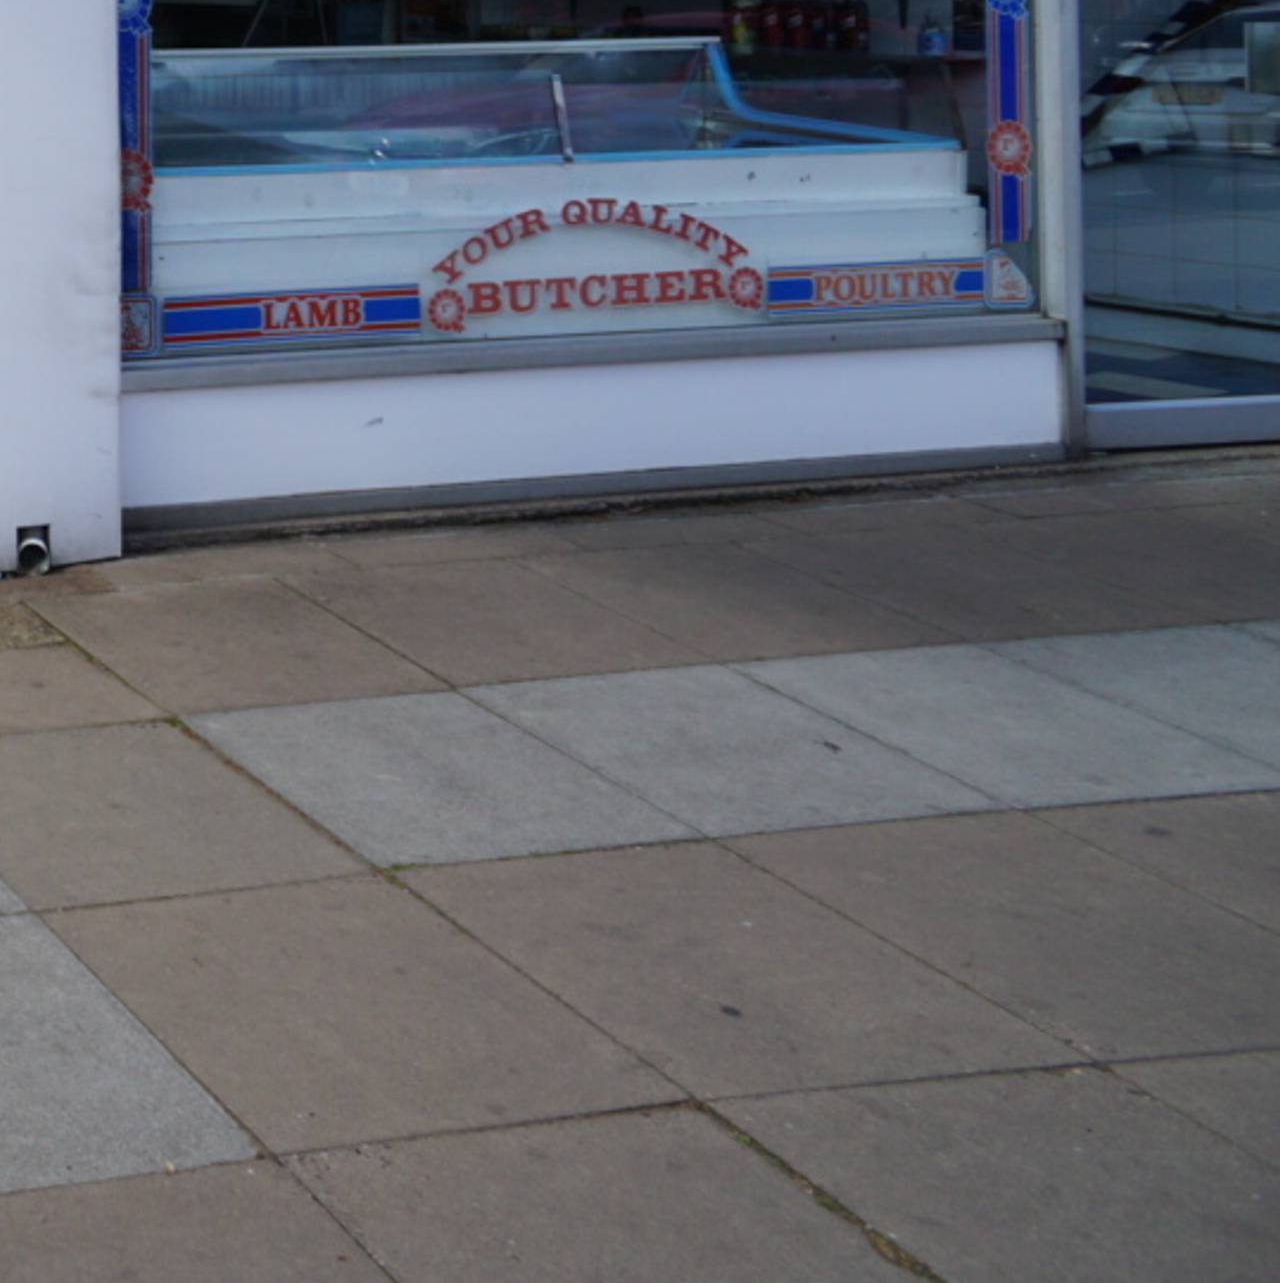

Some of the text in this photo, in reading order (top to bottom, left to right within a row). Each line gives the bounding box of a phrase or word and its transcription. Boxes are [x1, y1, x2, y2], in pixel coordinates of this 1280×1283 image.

[432, 198, 750, 284] YOUR QUALITY
[466, 268, 727, 315] BUTCHER
[812, 267, 956, 304] POULTRY
[261, 299, 362, 332] LAMB
